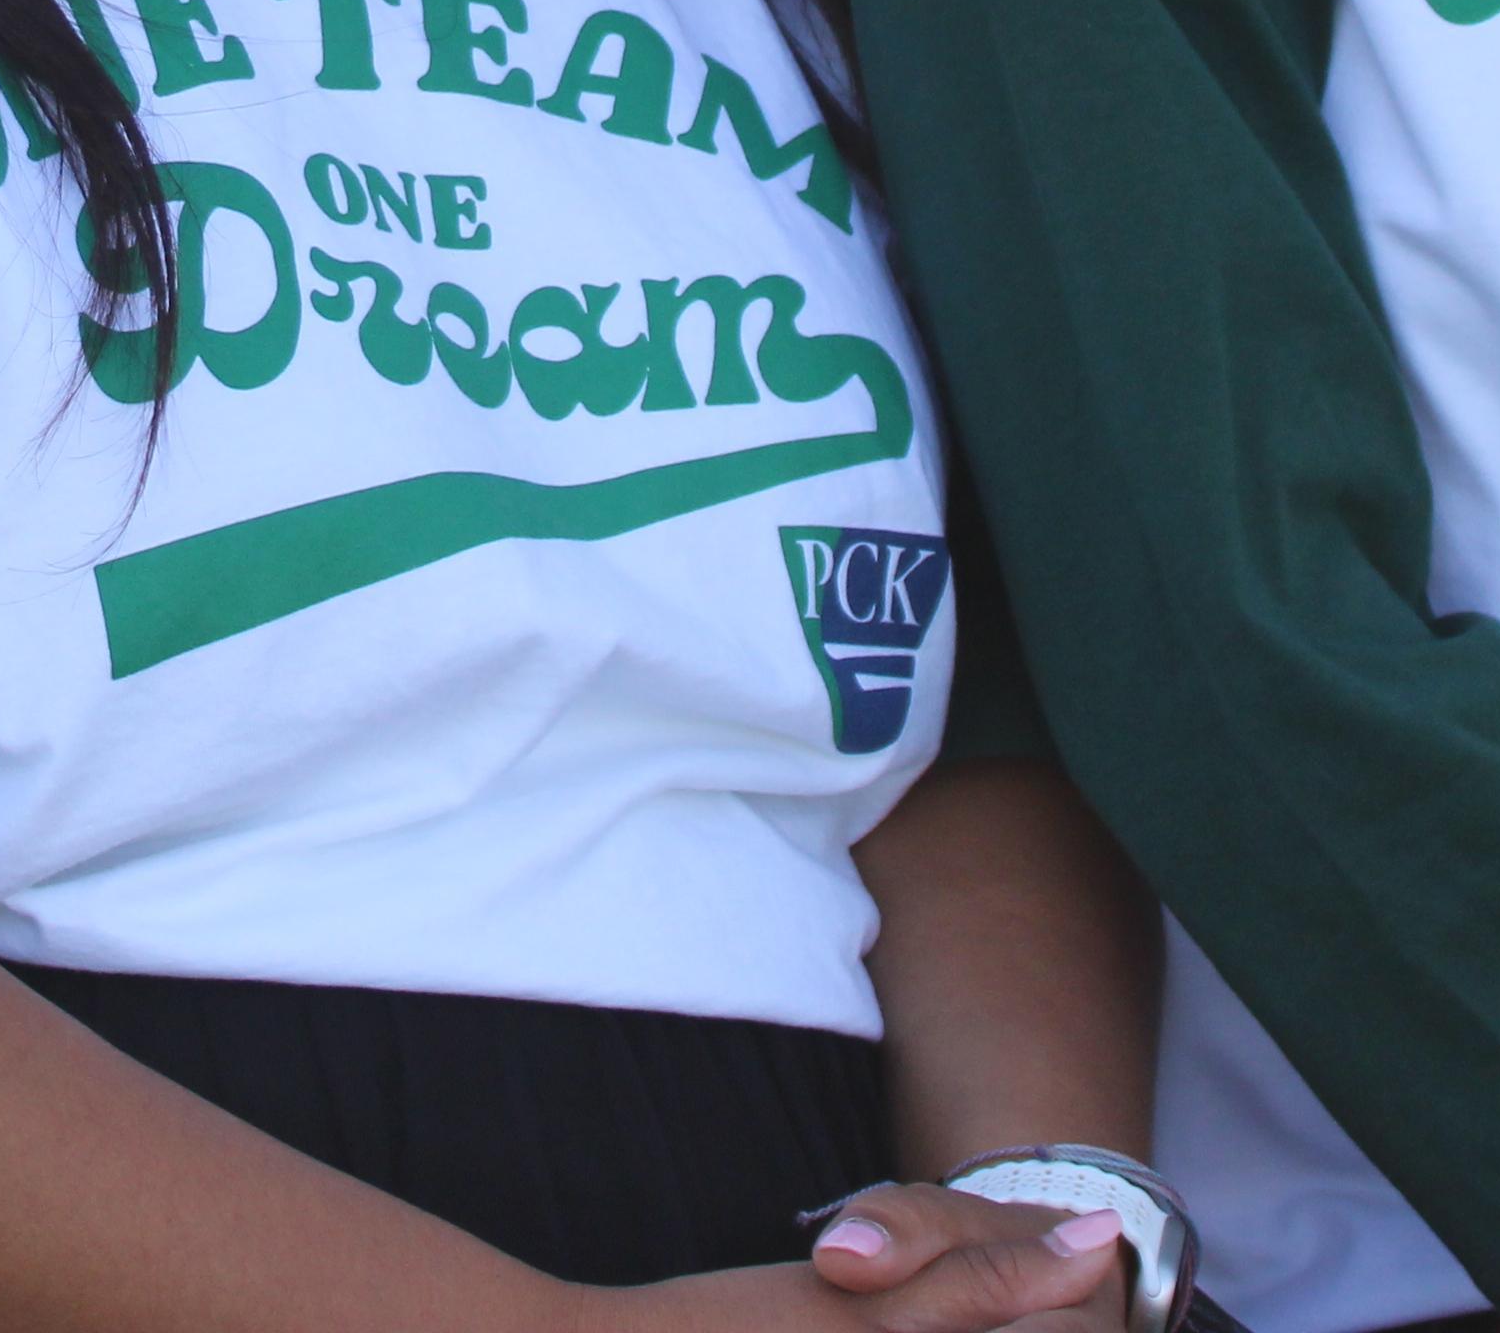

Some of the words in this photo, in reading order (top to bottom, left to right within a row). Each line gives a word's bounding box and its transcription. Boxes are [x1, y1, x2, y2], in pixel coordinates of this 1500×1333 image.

[303, 153, 491, 250] ONE
[76, 161, 914, 458] Dream
[795, 538, 937, 627] PCK
